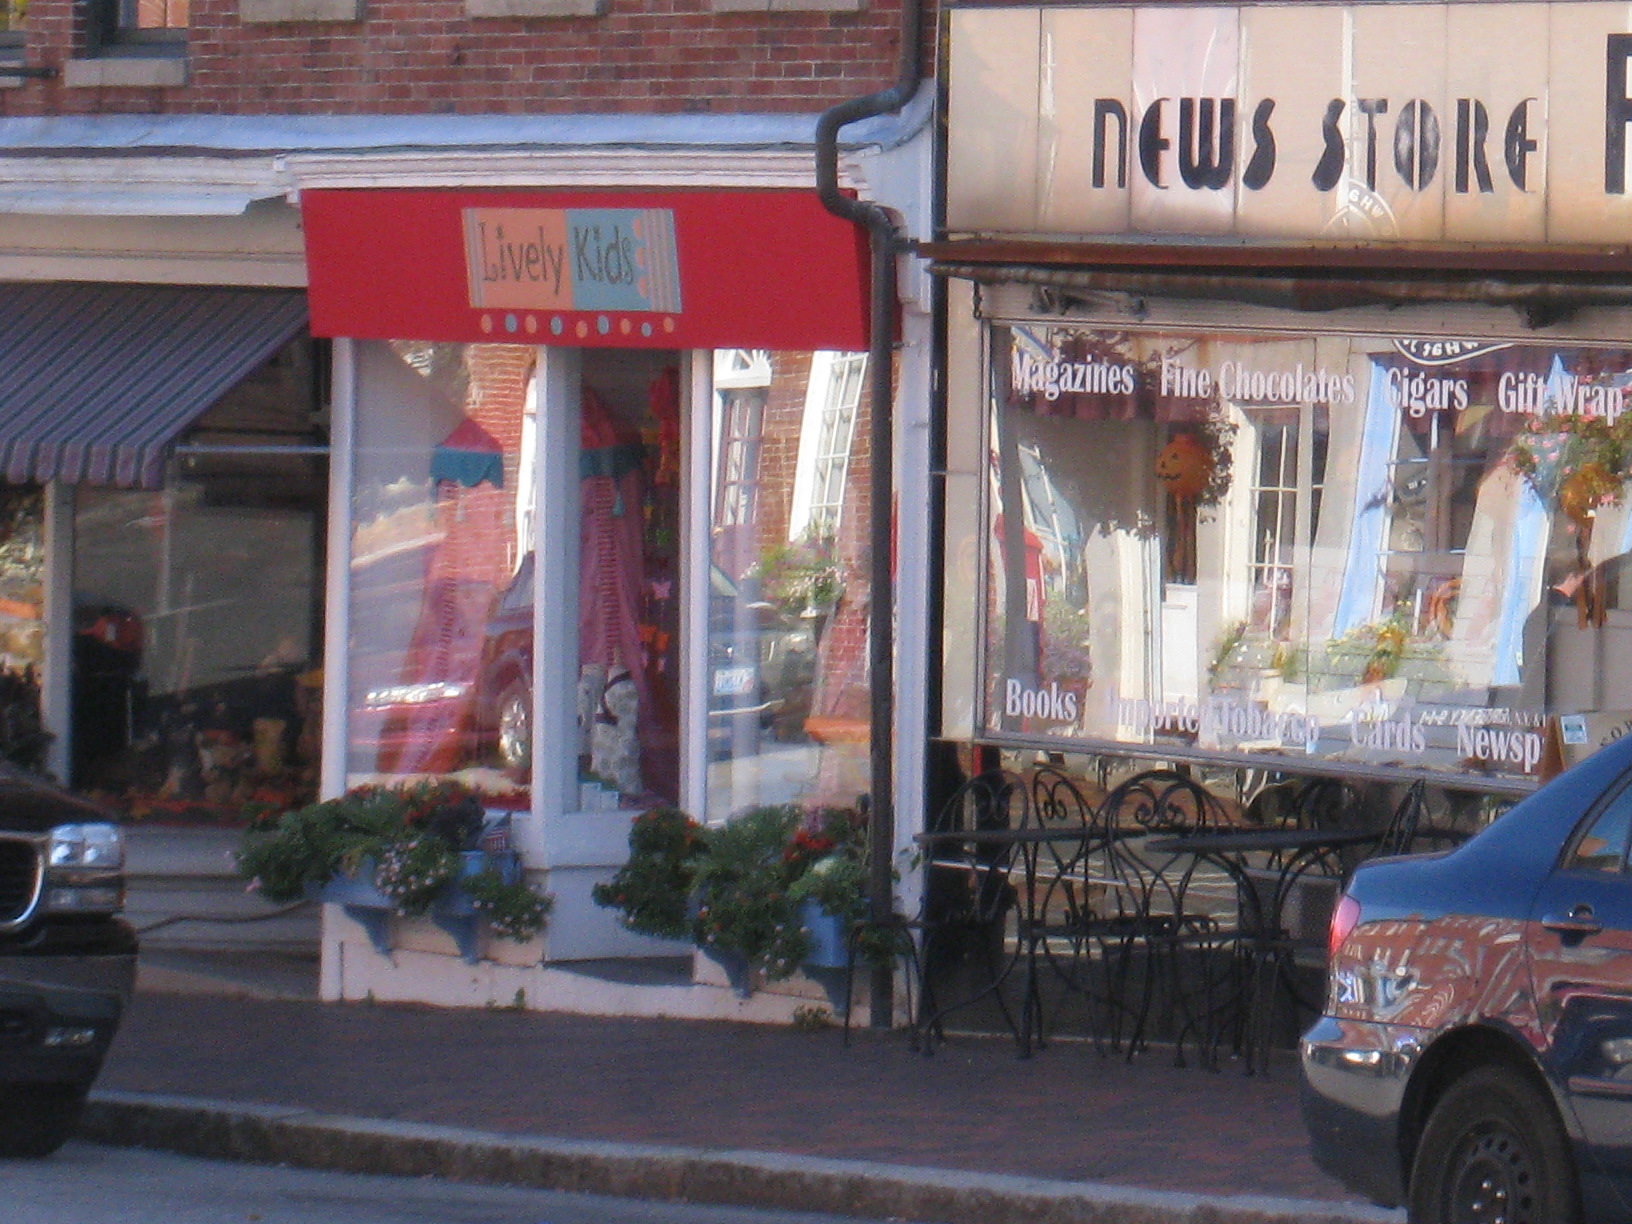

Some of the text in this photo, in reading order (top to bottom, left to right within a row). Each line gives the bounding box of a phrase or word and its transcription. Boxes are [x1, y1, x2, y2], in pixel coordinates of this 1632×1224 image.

[1091, 97, 1277, 190] NEWS
[1312, 97, 1539, 194] STORE
[477, 222, 635, 296] Lively Kids
[1011, 354, 1624, 427] Magazines Fine Chocolates Cigars Gift Wrap
[1004, 677, 1078, 722] Books
[1350, 708, 1426, 753] Cards
[1457, 722, 1545, 774] Newsp
